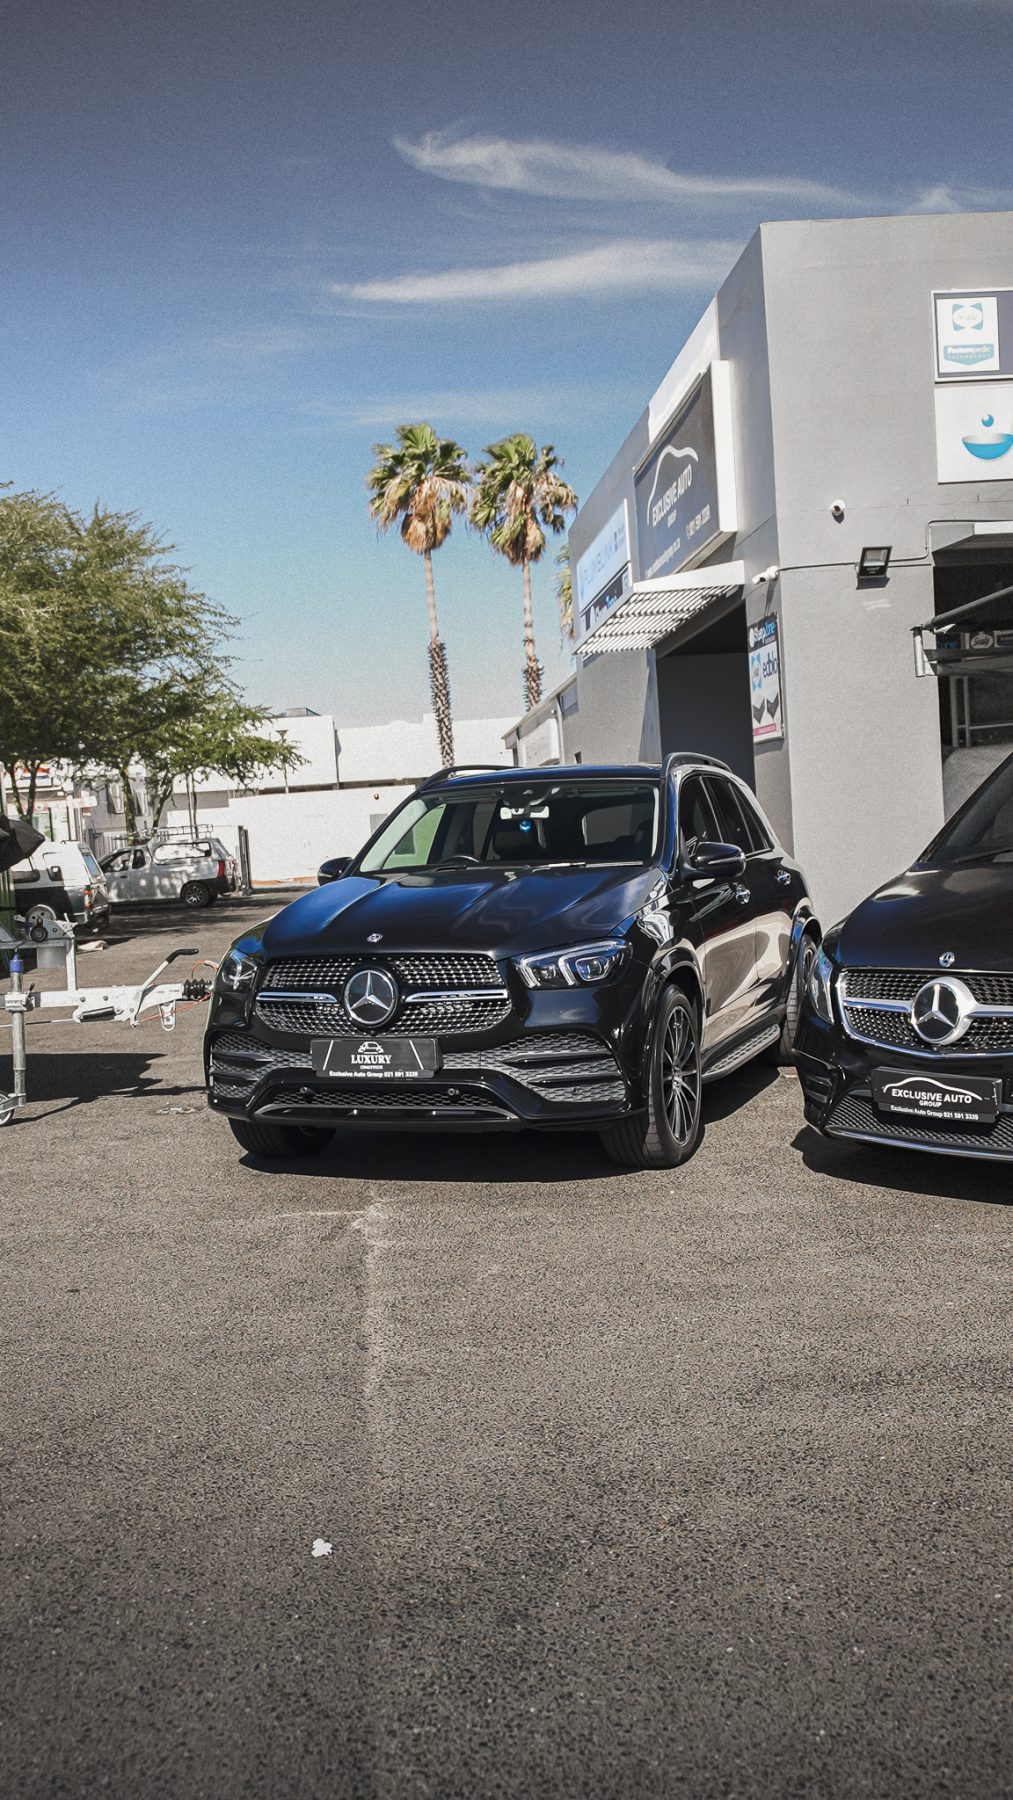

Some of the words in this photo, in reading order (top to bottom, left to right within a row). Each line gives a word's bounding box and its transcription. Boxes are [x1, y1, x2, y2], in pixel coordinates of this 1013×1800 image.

[652, 481, 678, 528] EXCLUSIVE
[678, 463, 692, 499] AUTO
[351, 1054, 392, 1065] LUXURY
[329, 1070, 353, 1078] Exclusive
[353, 1070, 366, 1078] Auto
[366, 1071, 383, 1079] Group
[891, 1088, 943, 1102] EXCLUSIVE
[943, 1093, 972, 1104] AUTO
[890, 1104, 914, 1114] Exclusive
[927, 1109, 943, 1118] Group
